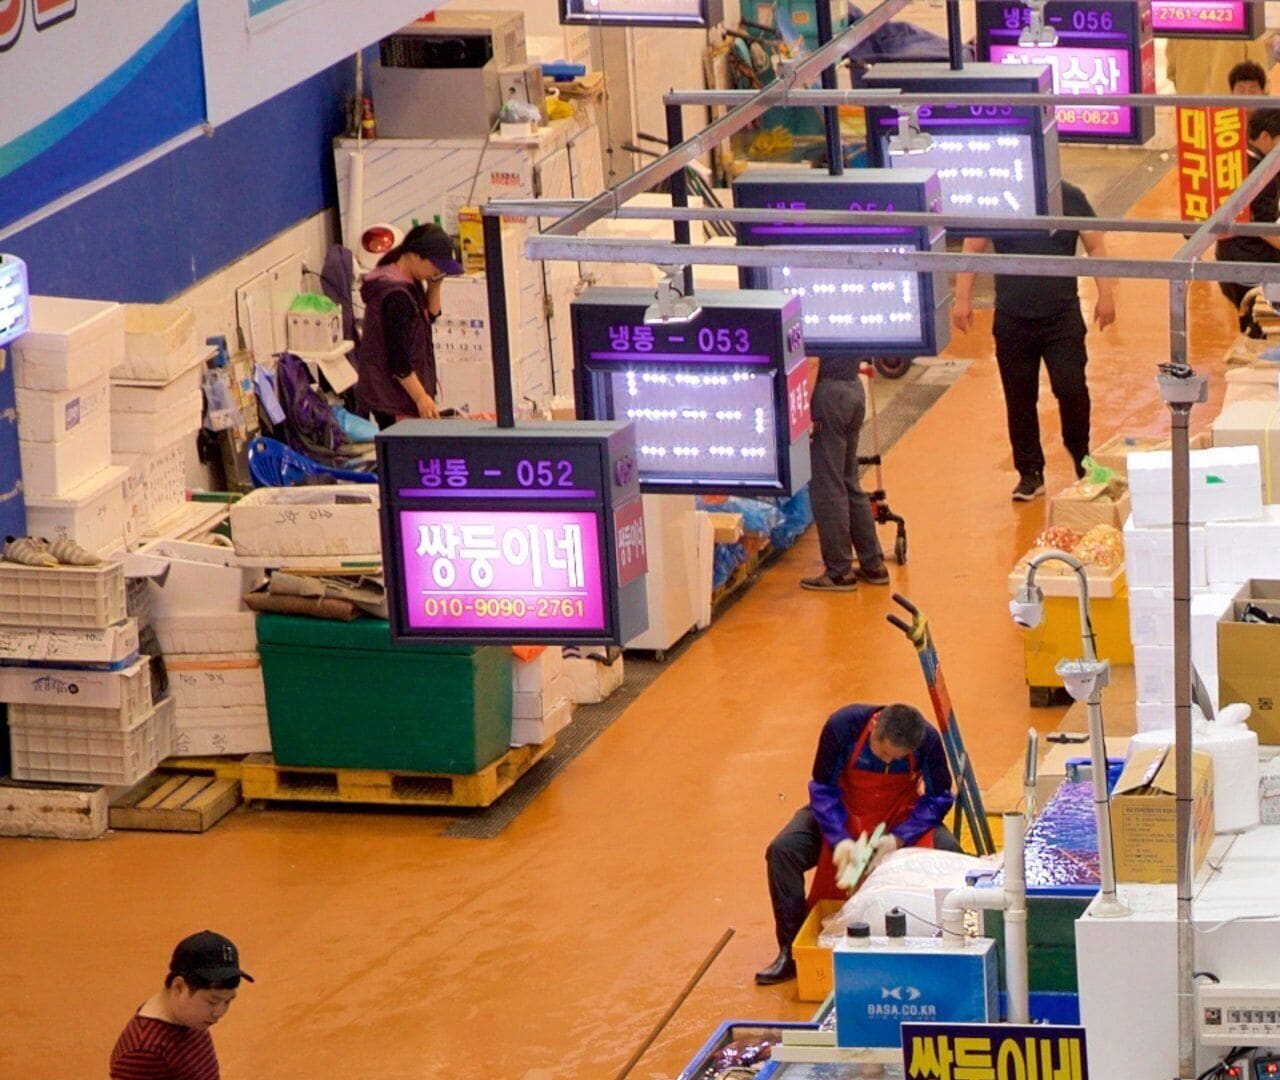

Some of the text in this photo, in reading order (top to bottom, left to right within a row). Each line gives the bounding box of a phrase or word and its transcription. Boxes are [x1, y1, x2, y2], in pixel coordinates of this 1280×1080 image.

[1074, 10, 1113, 30] 056
[1001, 53, 1120, 95] 수산
[1180, 108, 1208, 222] 대구포
[1213, 108, 1244, 208] 동태
[608, 325, 655, 352] 냉동
[698, 328, 750, 352] 053
[418, 458, 469, 488] 냉동
[516, 460, 574, 487] 052
[415, 523, 585, 589] 쌍둥이네
[424, 598, 584, 618] 010-9090-2761
[867, 1003, 937, 1016] BASA.CO.KR
